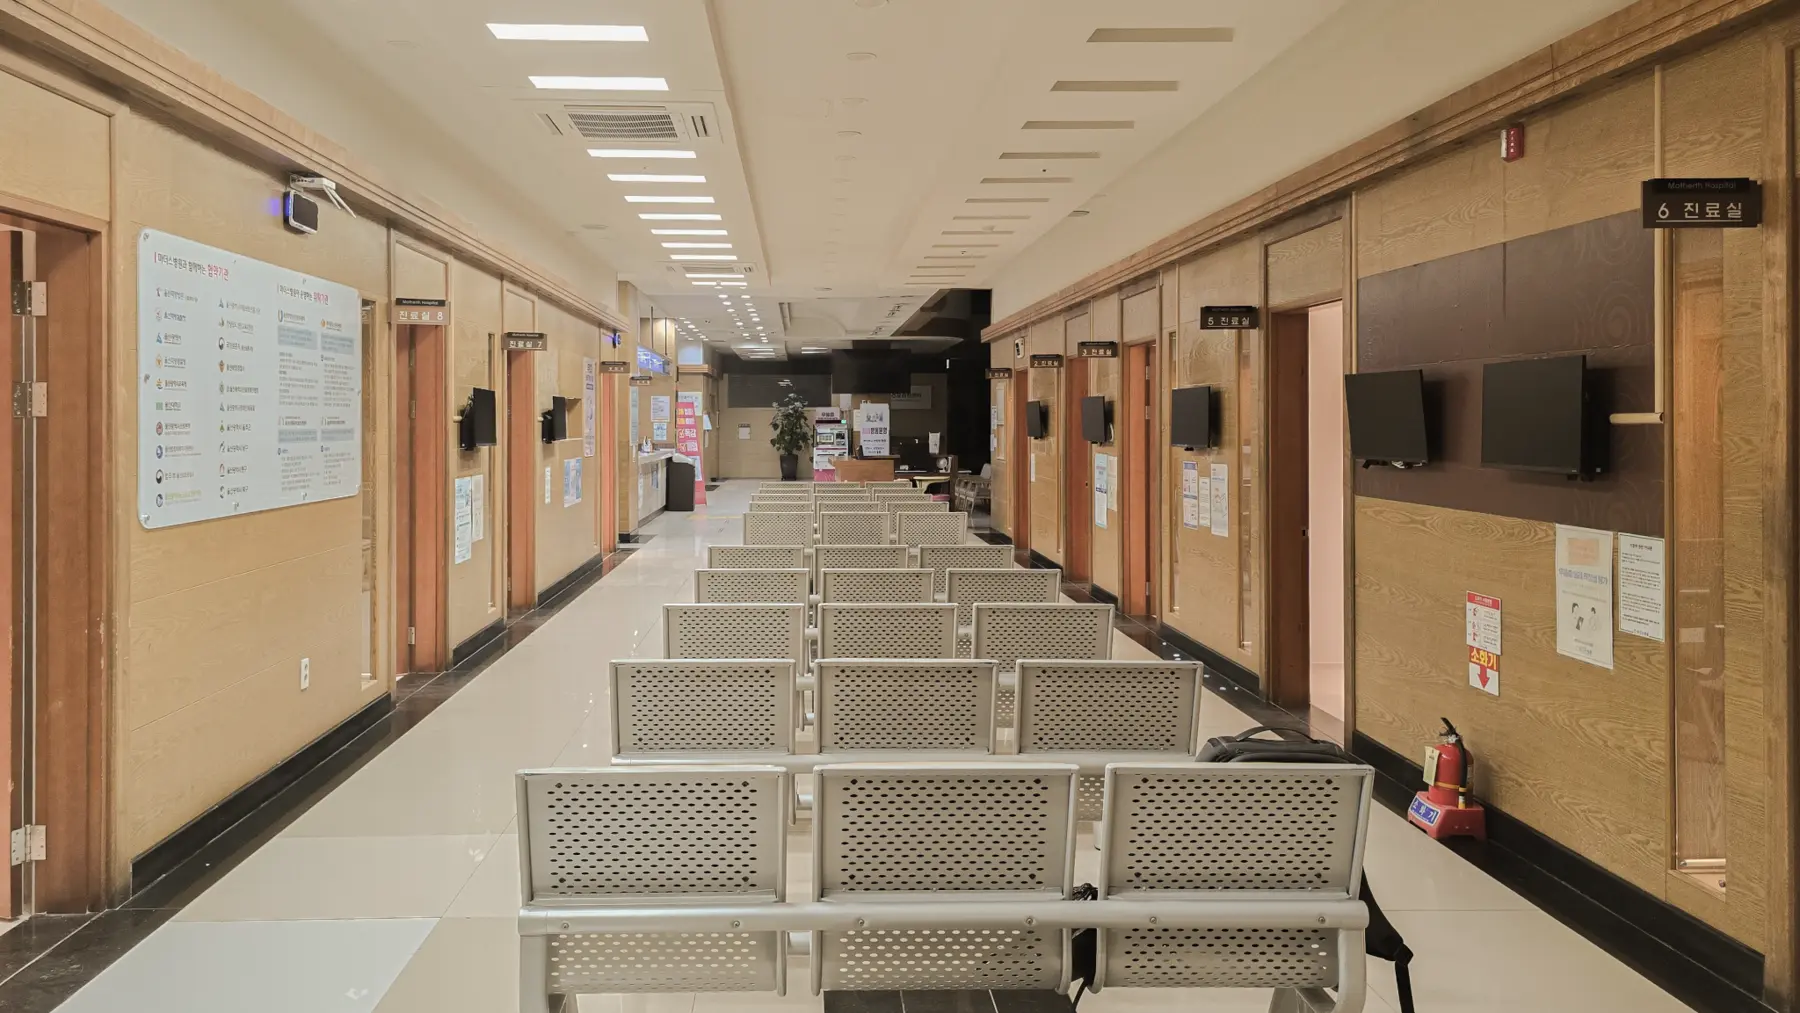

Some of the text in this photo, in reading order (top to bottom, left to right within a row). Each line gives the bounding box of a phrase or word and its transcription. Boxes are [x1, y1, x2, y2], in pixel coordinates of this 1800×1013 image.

[1704, 180, 1737, 190] Hospital
[1657, 202, 1742, 219] 6 진료실
[399, 311, 444, 321] 진료실 8
[1207, 316, 1250, 326] 5 진료실
[1471, 647, 1497, 671] 소화기
